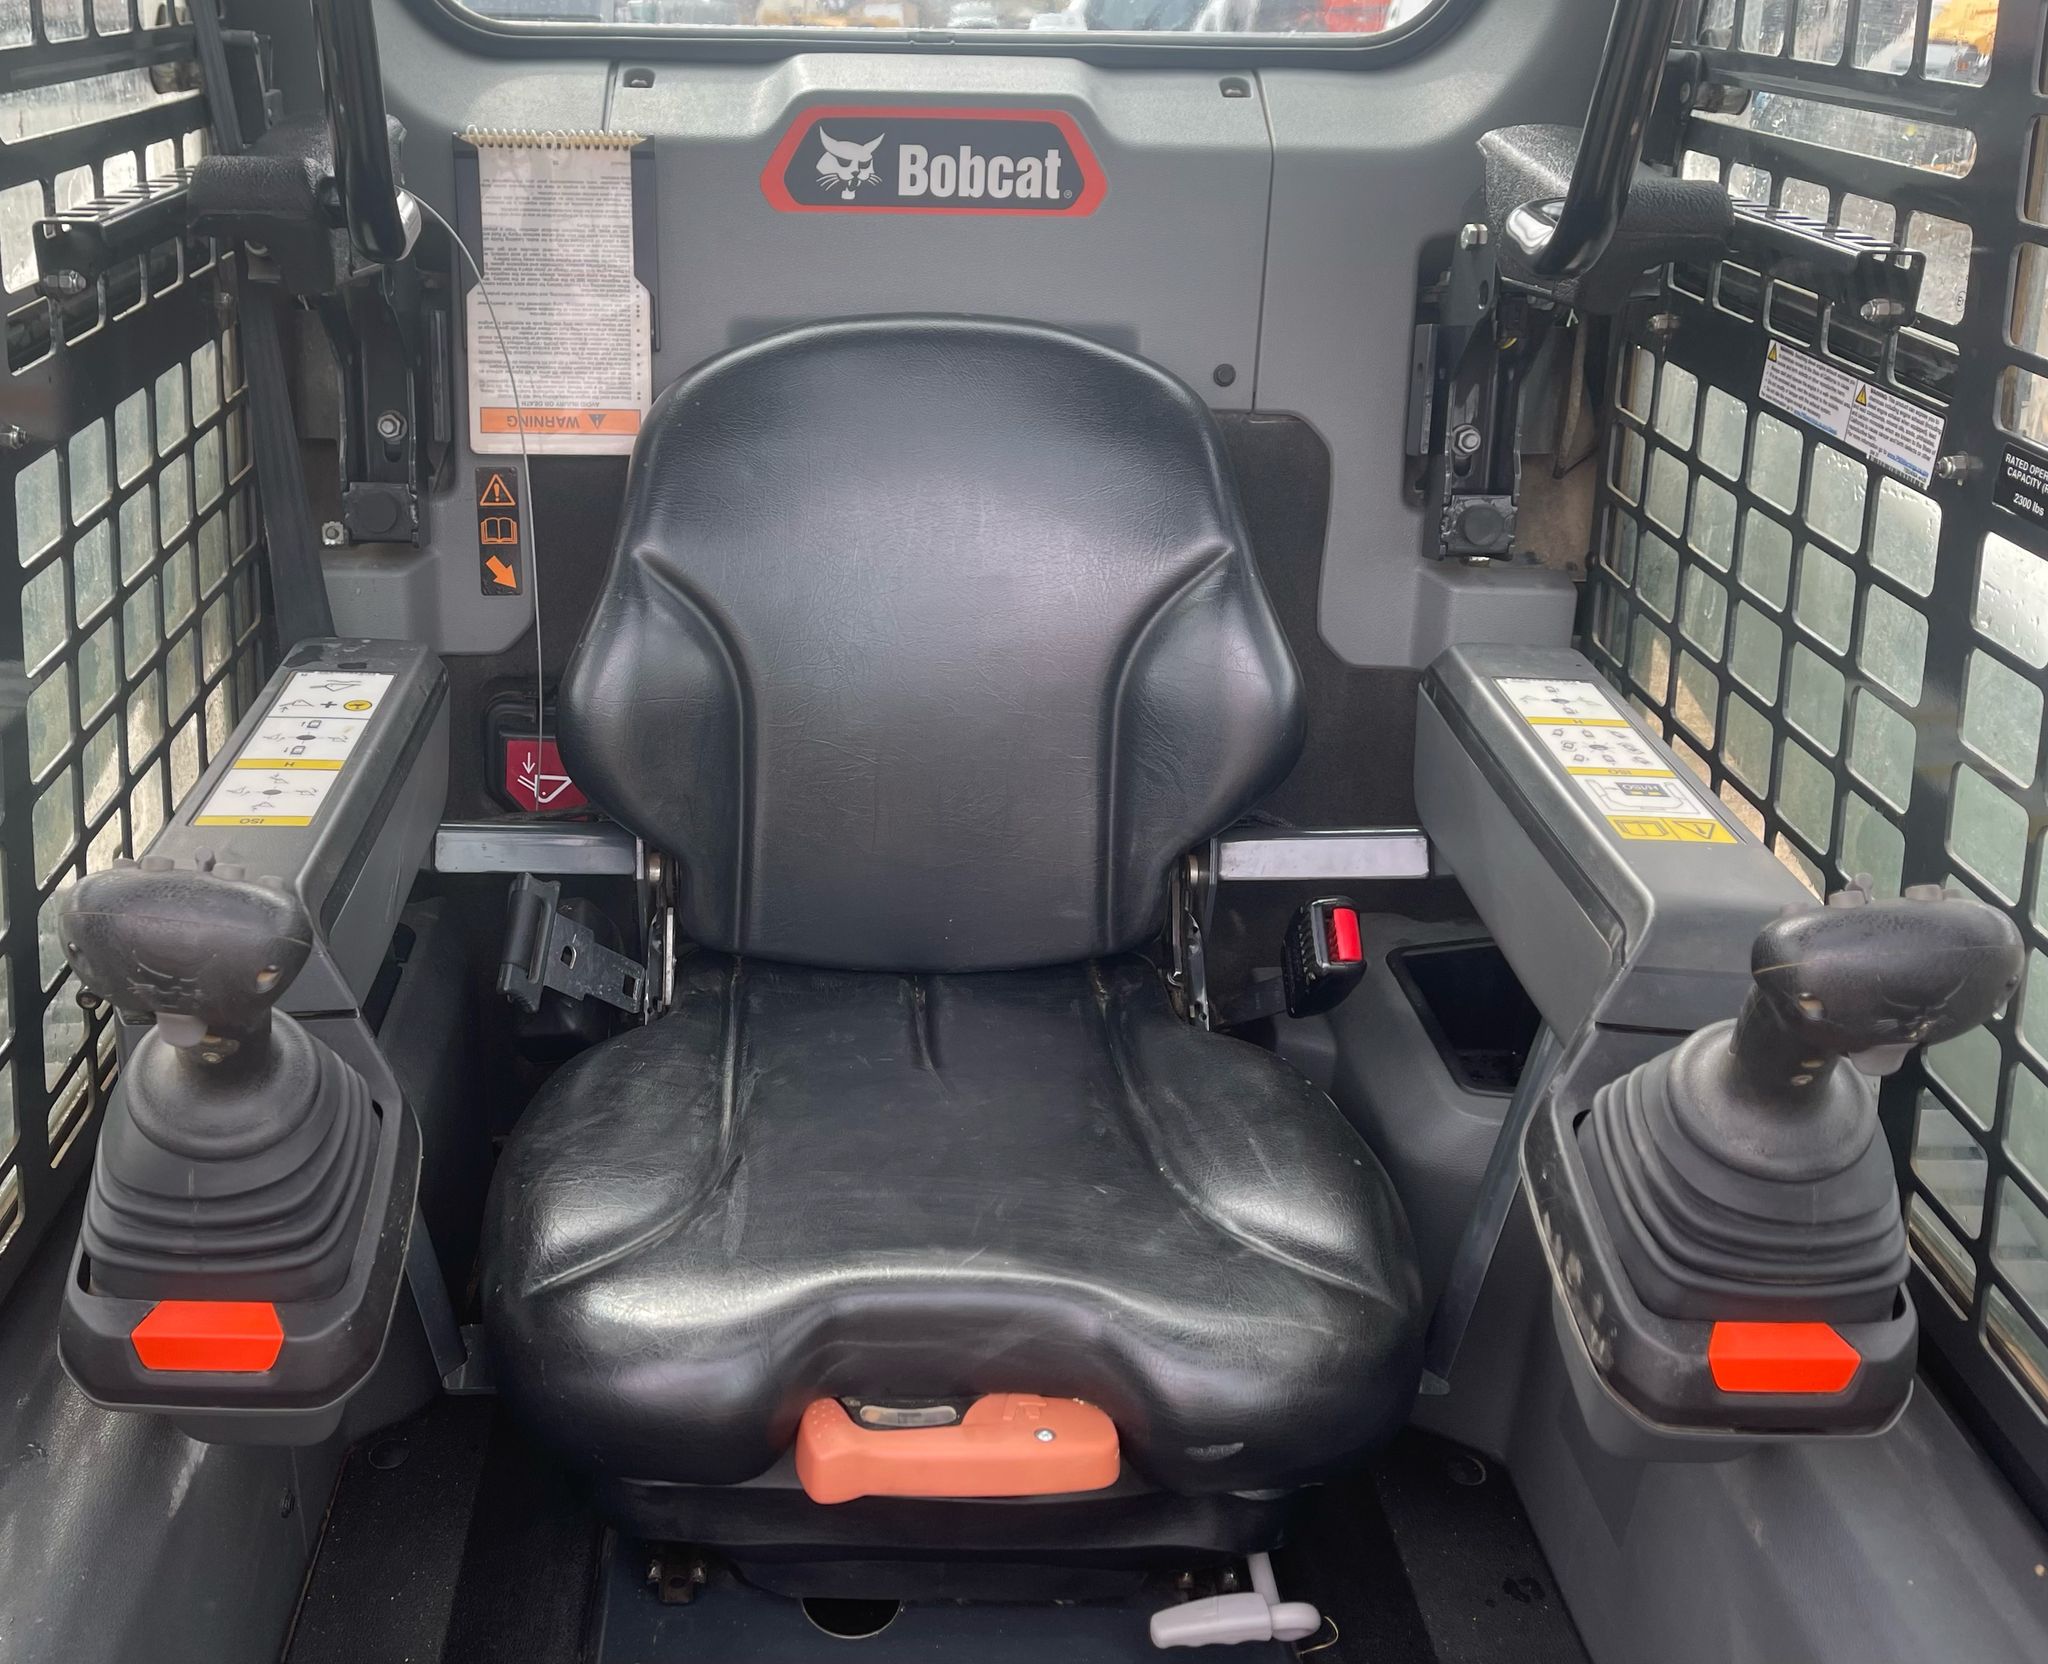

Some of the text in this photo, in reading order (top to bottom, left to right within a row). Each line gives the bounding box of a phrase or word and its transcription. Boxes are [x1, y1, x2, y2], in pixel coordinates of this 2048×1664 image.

[898, 144, 1061, 199] Bobcat
[507, 415, 580, 429] WARNING
[2005, 453, 2029, 471] RATED
[2007, 467, 2042, 489] CAPACITY
[2013, 493, 2045, 516] 2300 lbs
